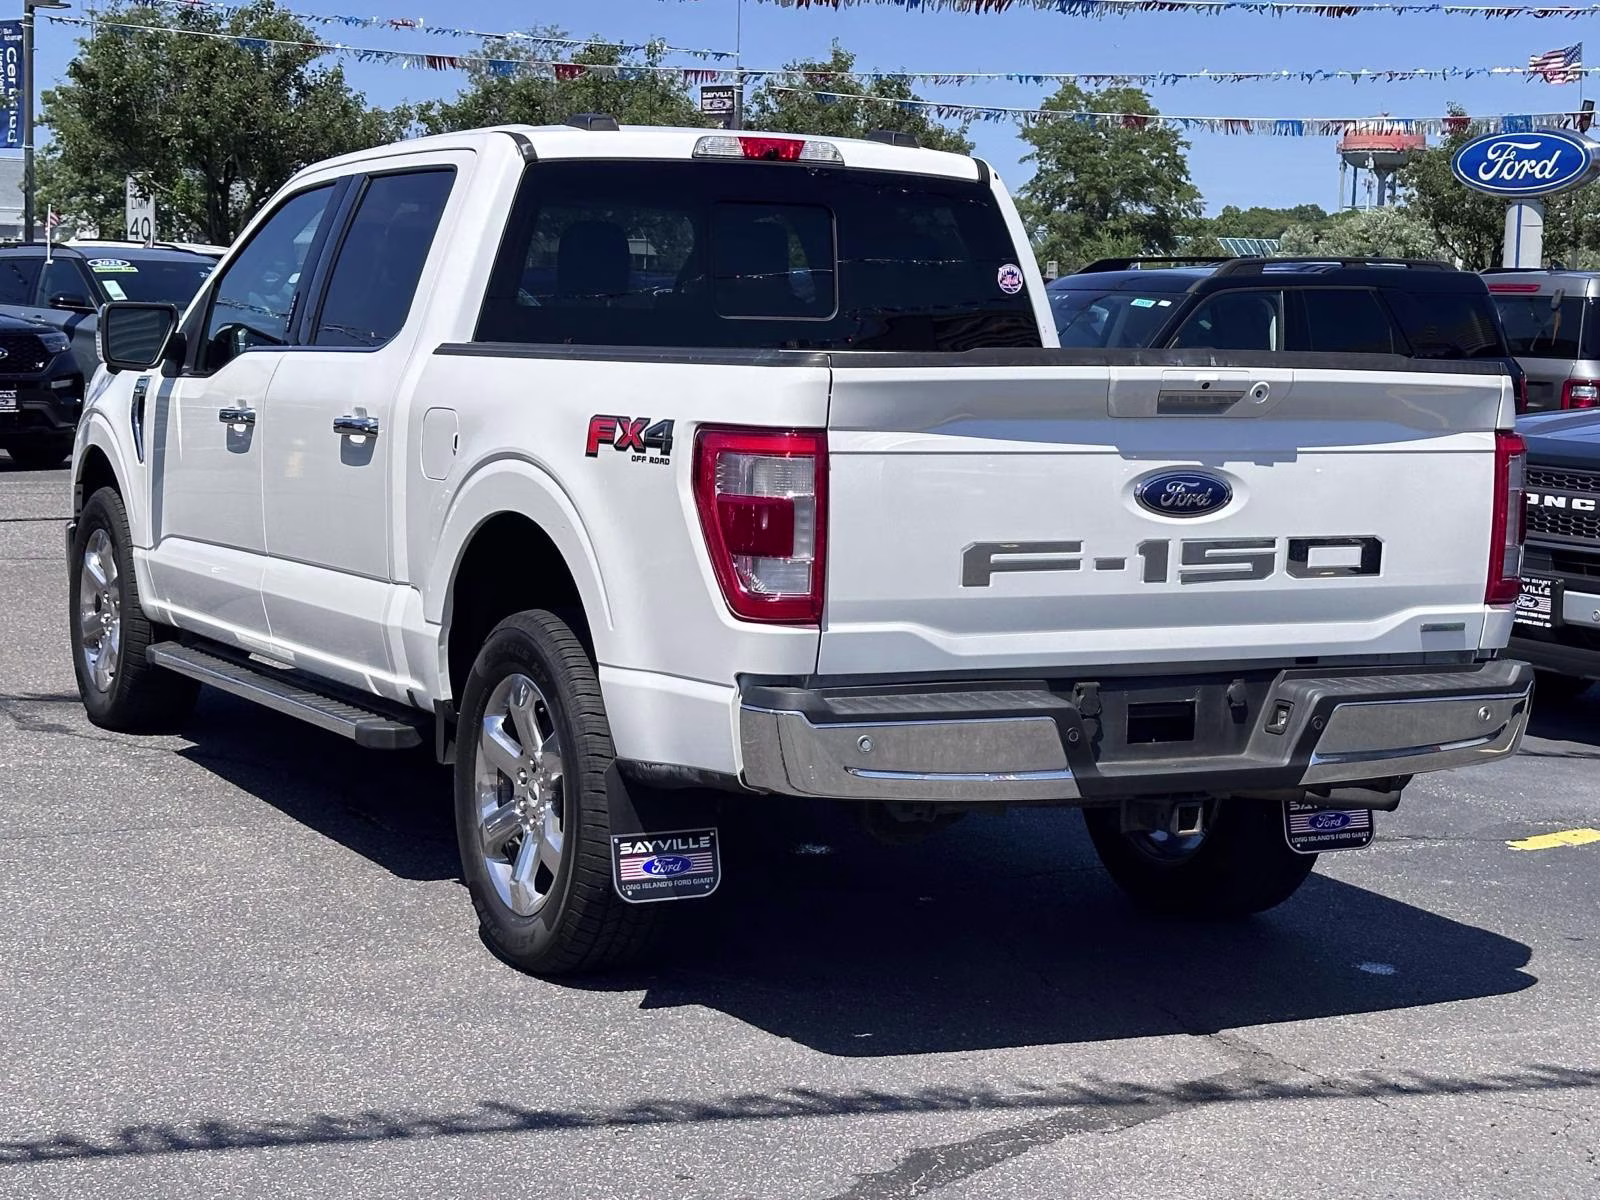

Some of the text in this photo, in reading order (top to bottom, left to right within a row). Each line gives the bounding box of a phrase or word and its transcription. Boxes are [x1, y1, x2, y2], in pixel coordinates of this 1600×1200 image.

[1478, 141, 1562, 181] Ford
[130, 217, 151, 241] 40
[585, 414, 675, 458] FX4
[631, 455, 670, 466] OFF ROAD
[1160, 480, 1213, 507] Ford
[960, 535, 1386, 588] F-150
[1522, 584, 1551, 596] VILLE
[1316, 813, 1343, 828] Ford
[1335, 832, 1351, 840] FORD
[619, 836, 711, 855] SAYVILLE
[651, 858, 682, 874] Ford
[622, 877, 714, 891] LONG ISLAND'S FORD GIANT
